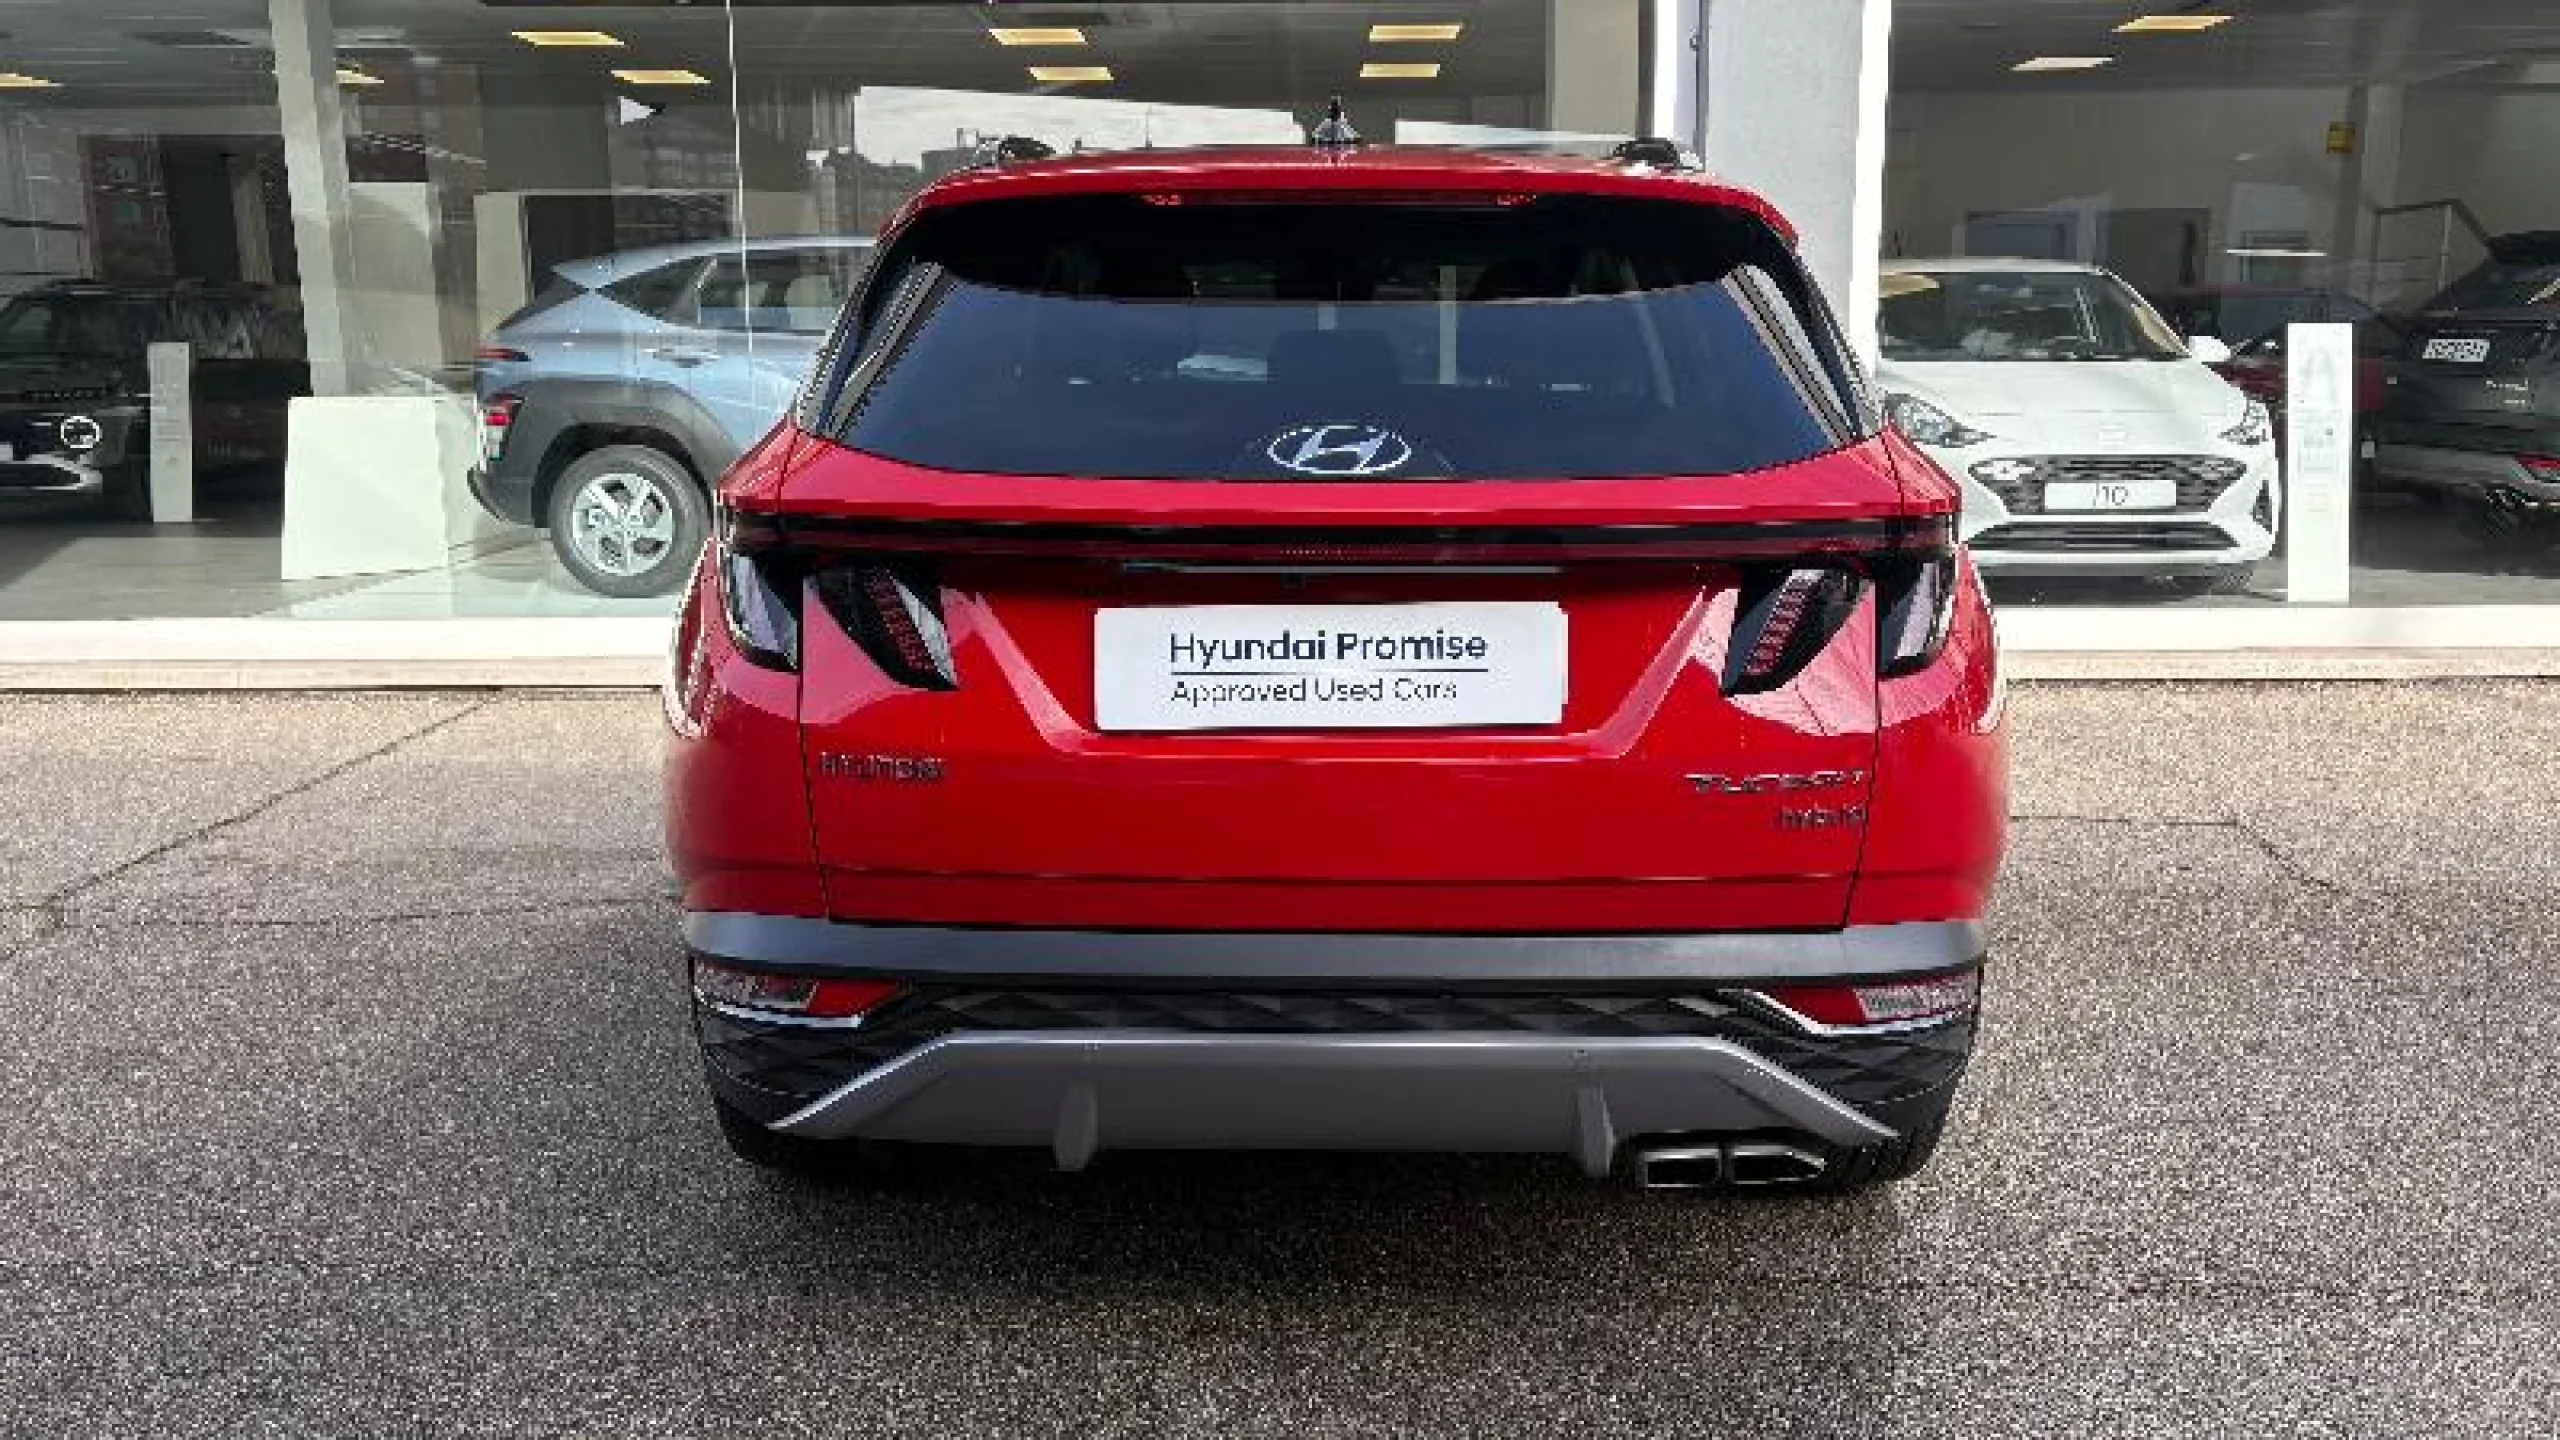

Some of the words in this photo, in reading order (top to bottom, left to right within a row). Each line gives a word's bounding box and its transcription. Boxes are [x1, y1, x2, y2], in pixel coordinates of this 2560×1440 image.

[1171, 630, 1325, 669] Hyundai
[1337, 629, 1488, 660] Promise
[1171, 678, 1306, 707] Approved
[1315, 678, 1383, 701] Used
[1394, 678, 1457, 701] Cars
